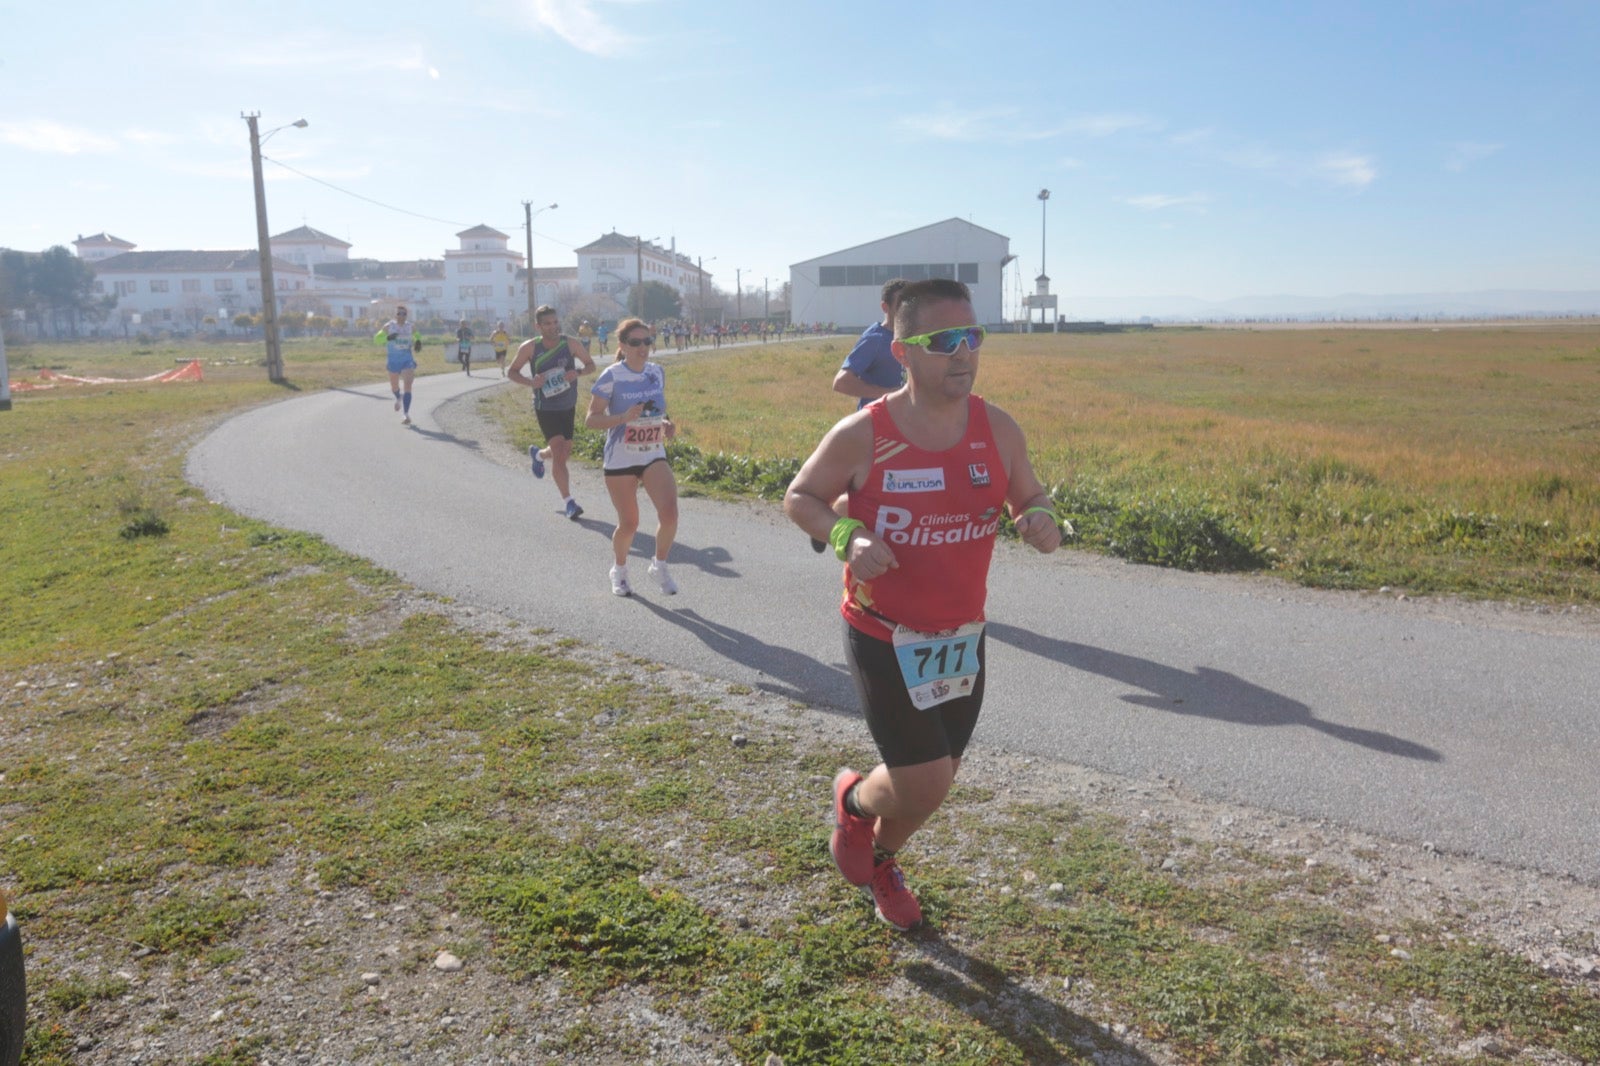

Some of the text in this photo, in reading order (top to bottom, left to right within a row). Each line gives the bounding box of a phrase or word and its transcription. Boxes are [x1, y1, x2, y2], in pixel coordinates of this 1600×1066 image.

[627, 427, 660, 442] 2027
[875, 505, 999, 545] Polisalud
[914, 642, 967, 678] 717
